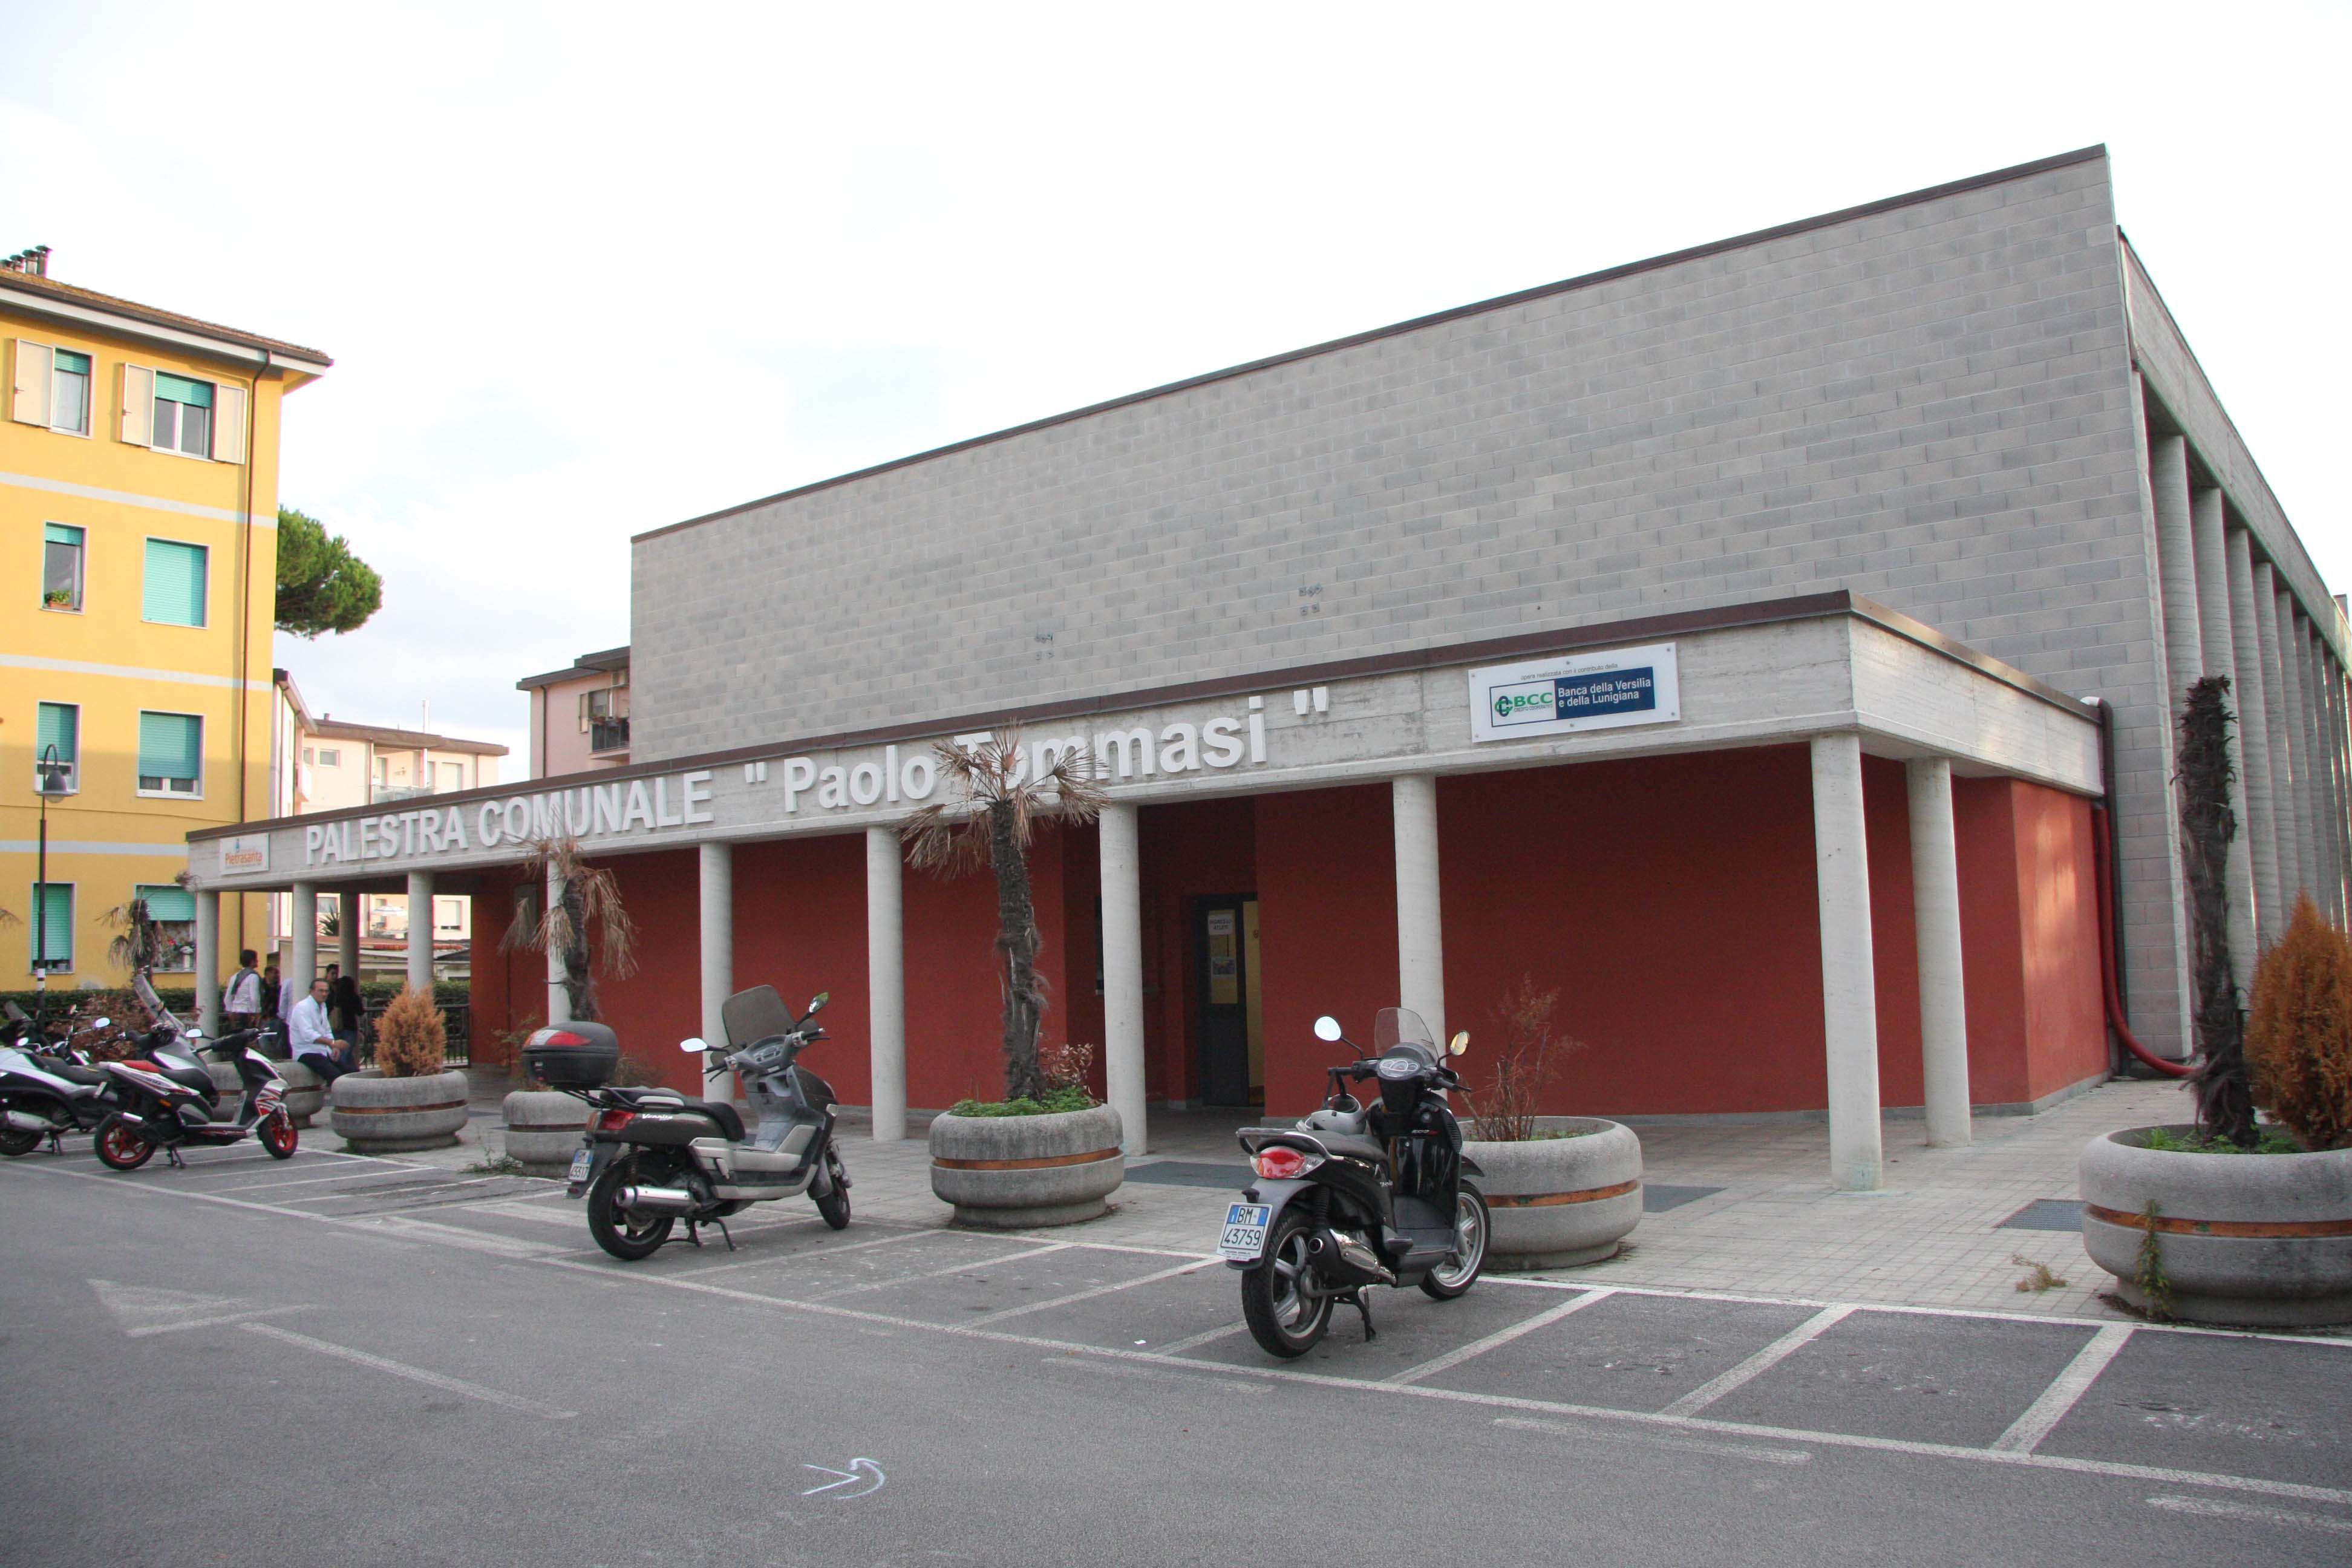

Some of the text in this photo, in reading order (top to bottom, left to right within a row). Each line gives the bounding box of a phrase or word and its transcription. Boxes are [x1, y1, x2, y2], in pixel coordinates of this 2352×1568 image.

[1578, 664, 1604, 673] contributo
[1558, 678, 1651, 697] Banca della Versilia
[1514, 692, 1553, 707] BCC
[1558, 691, 1639, 708] e della Lunigiana
[306, 806, 469, 866] PALESTRA
[479, 769, 715, 847] COMUNALE
[784, 744, 936, 812] Paolo
[225, 851, 263, 866] Pietrasanta
[1237, 1207, 1253, 1223] BM
[1224, 1228, 1261, 1246] 43759
